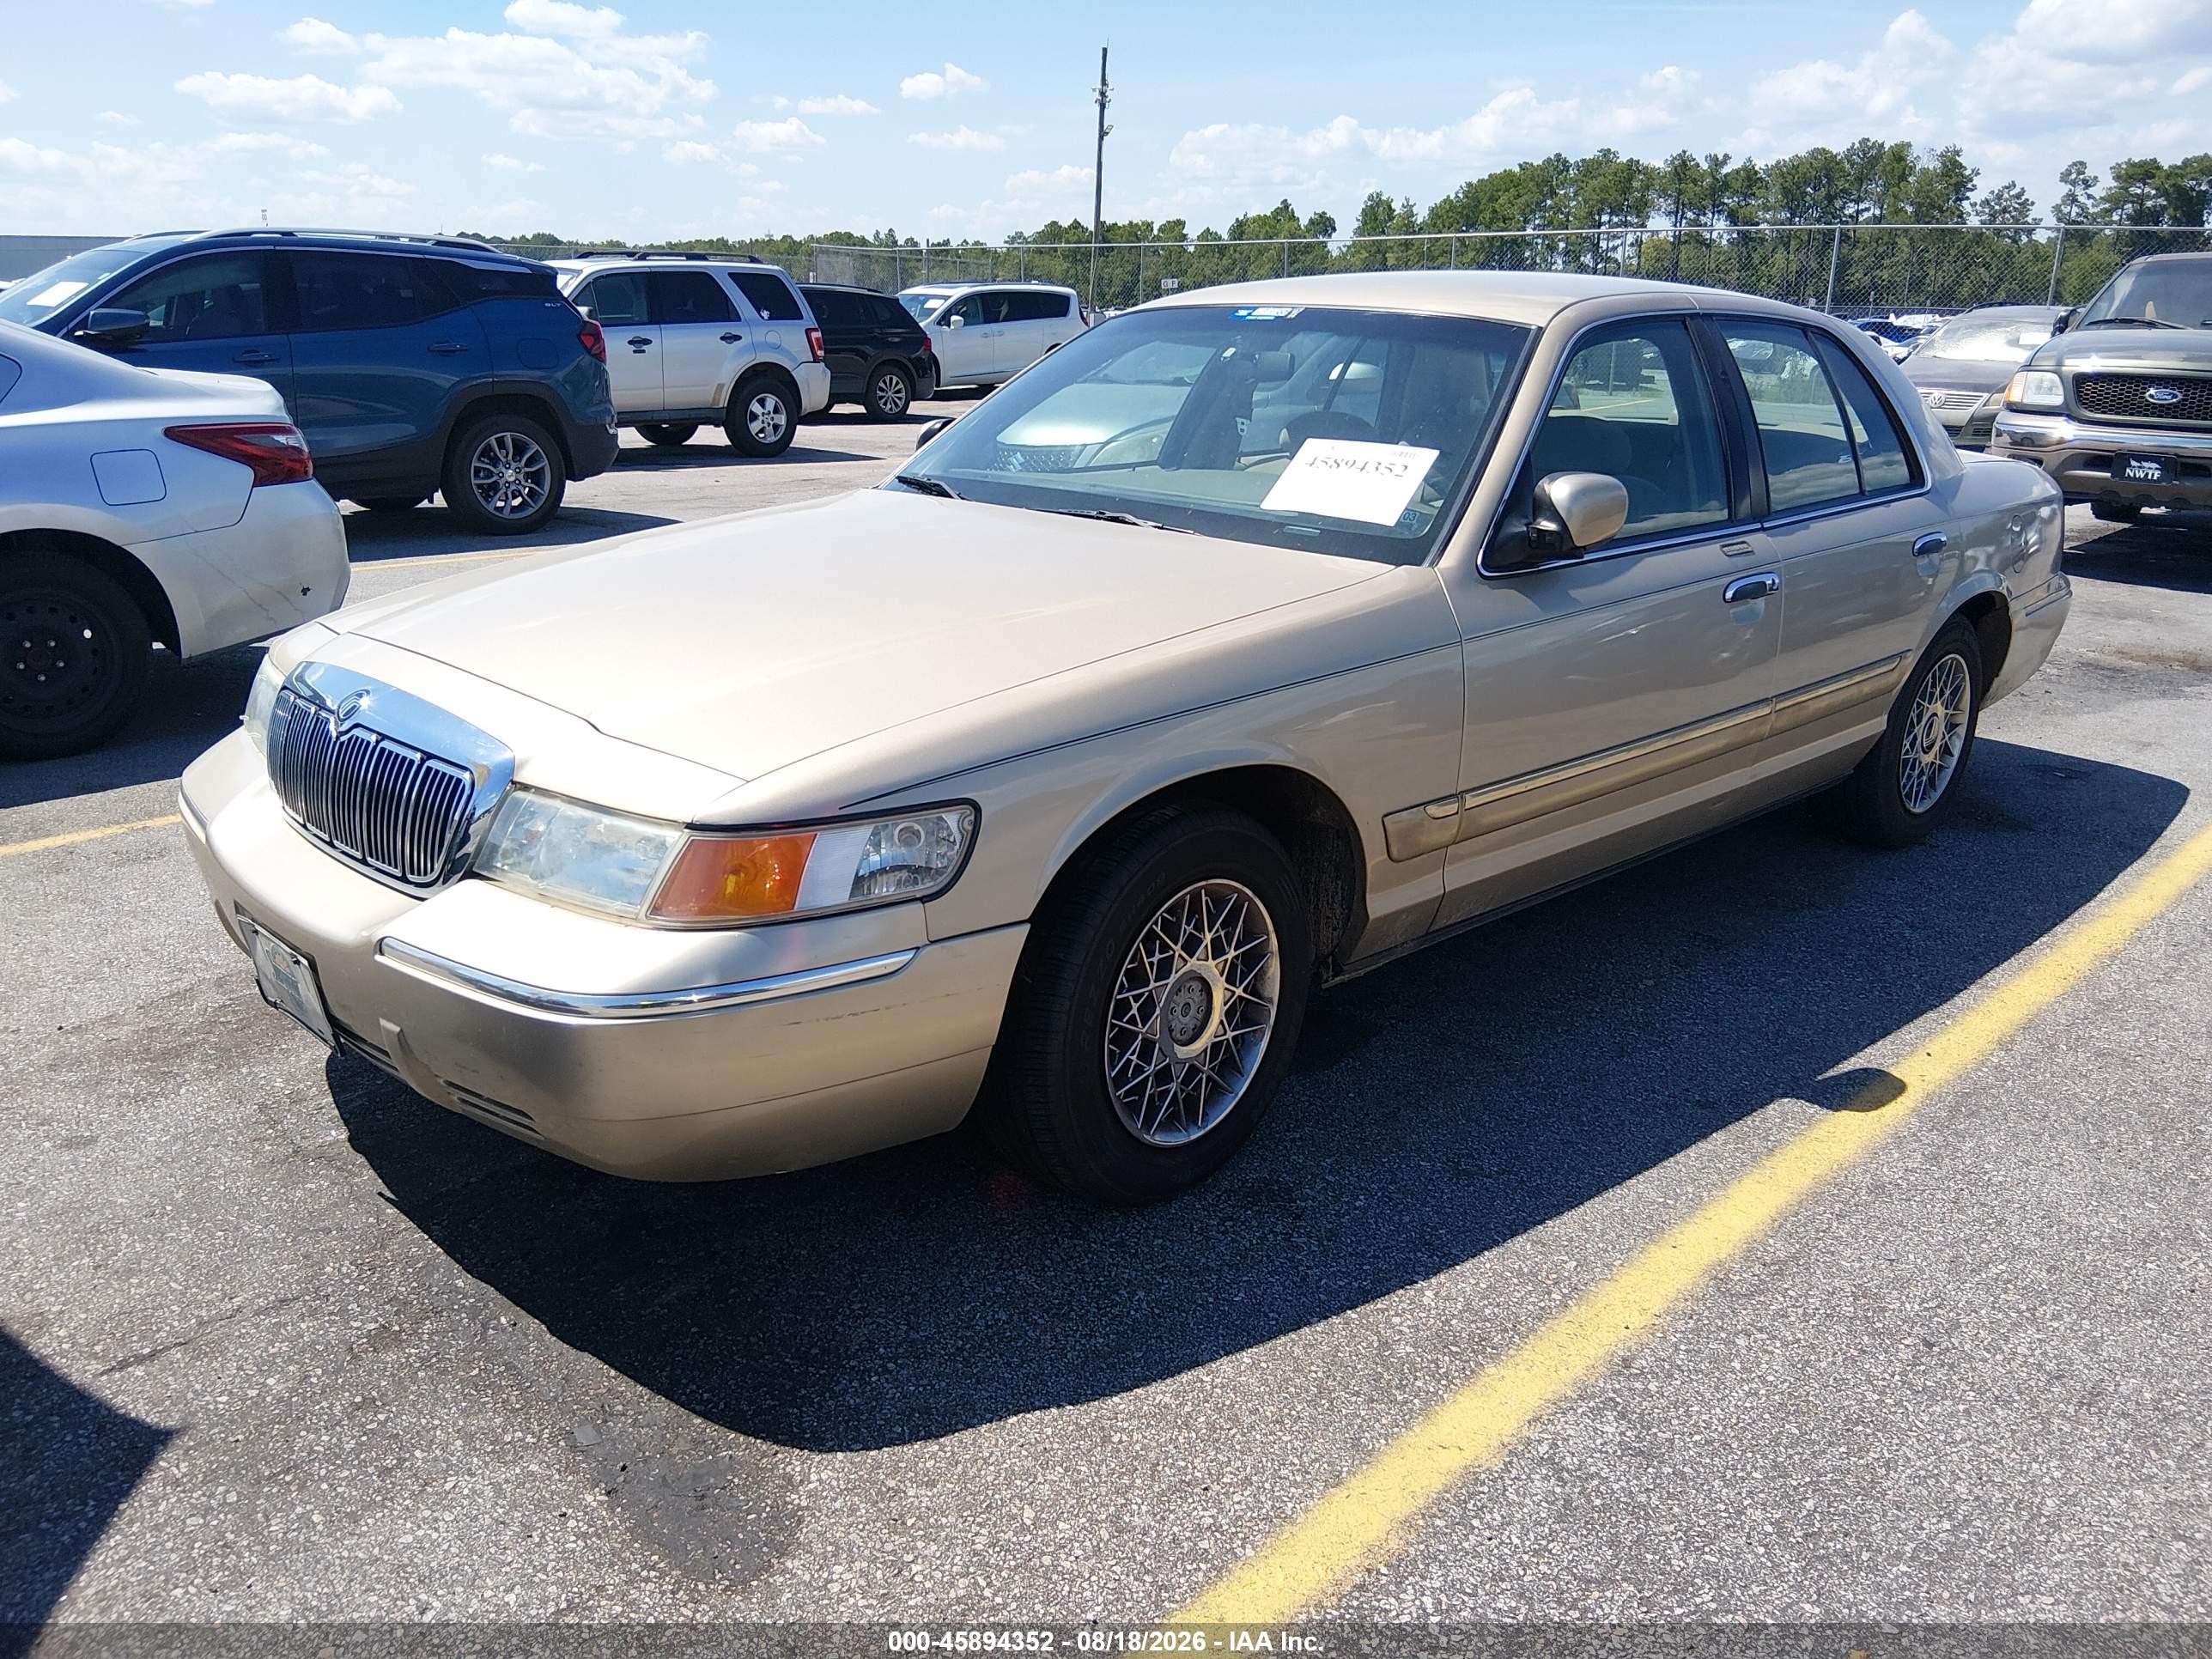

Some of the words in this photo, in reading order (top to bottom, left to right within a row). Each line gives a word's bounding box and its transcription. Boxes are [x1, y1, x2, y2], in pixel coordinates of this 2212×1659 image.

[1304, 456, 1409, 478] 45894352
[2124, 467, 2162, 480] NWTF
[1402, 512, 1417, 522] 03
